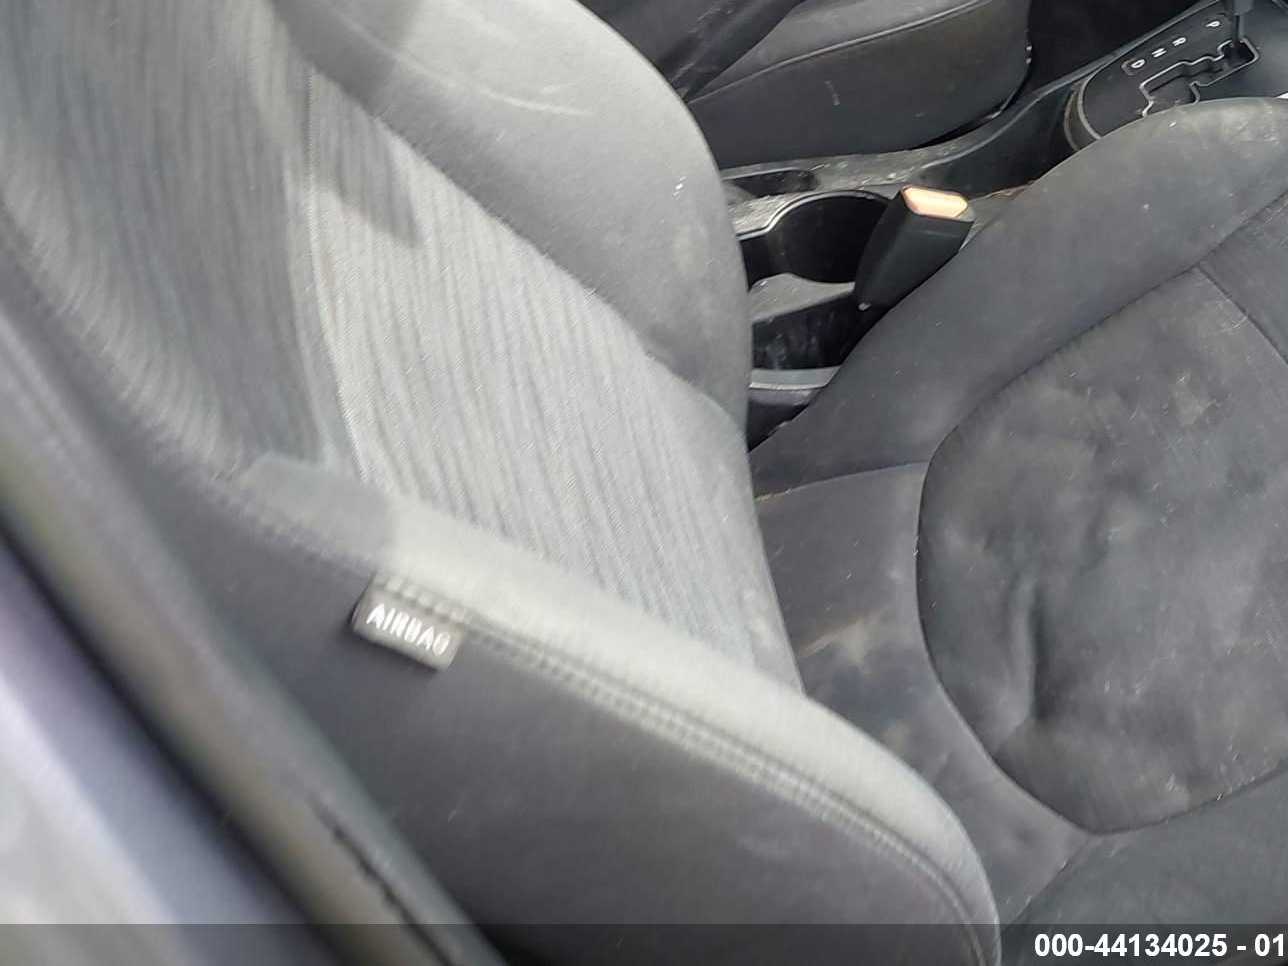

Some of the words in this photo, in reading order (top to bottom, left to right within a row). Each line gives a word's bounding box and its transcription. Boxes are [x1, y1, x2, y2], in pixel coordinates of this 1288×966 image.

[1205, 20, 1221, 28] P
[1172, 37, 1187, 46] R
[1151, 47, 1167, 58] N
[1131, 59, 1145, 68] D
[366, 602, 451, 655] AIRBAG
